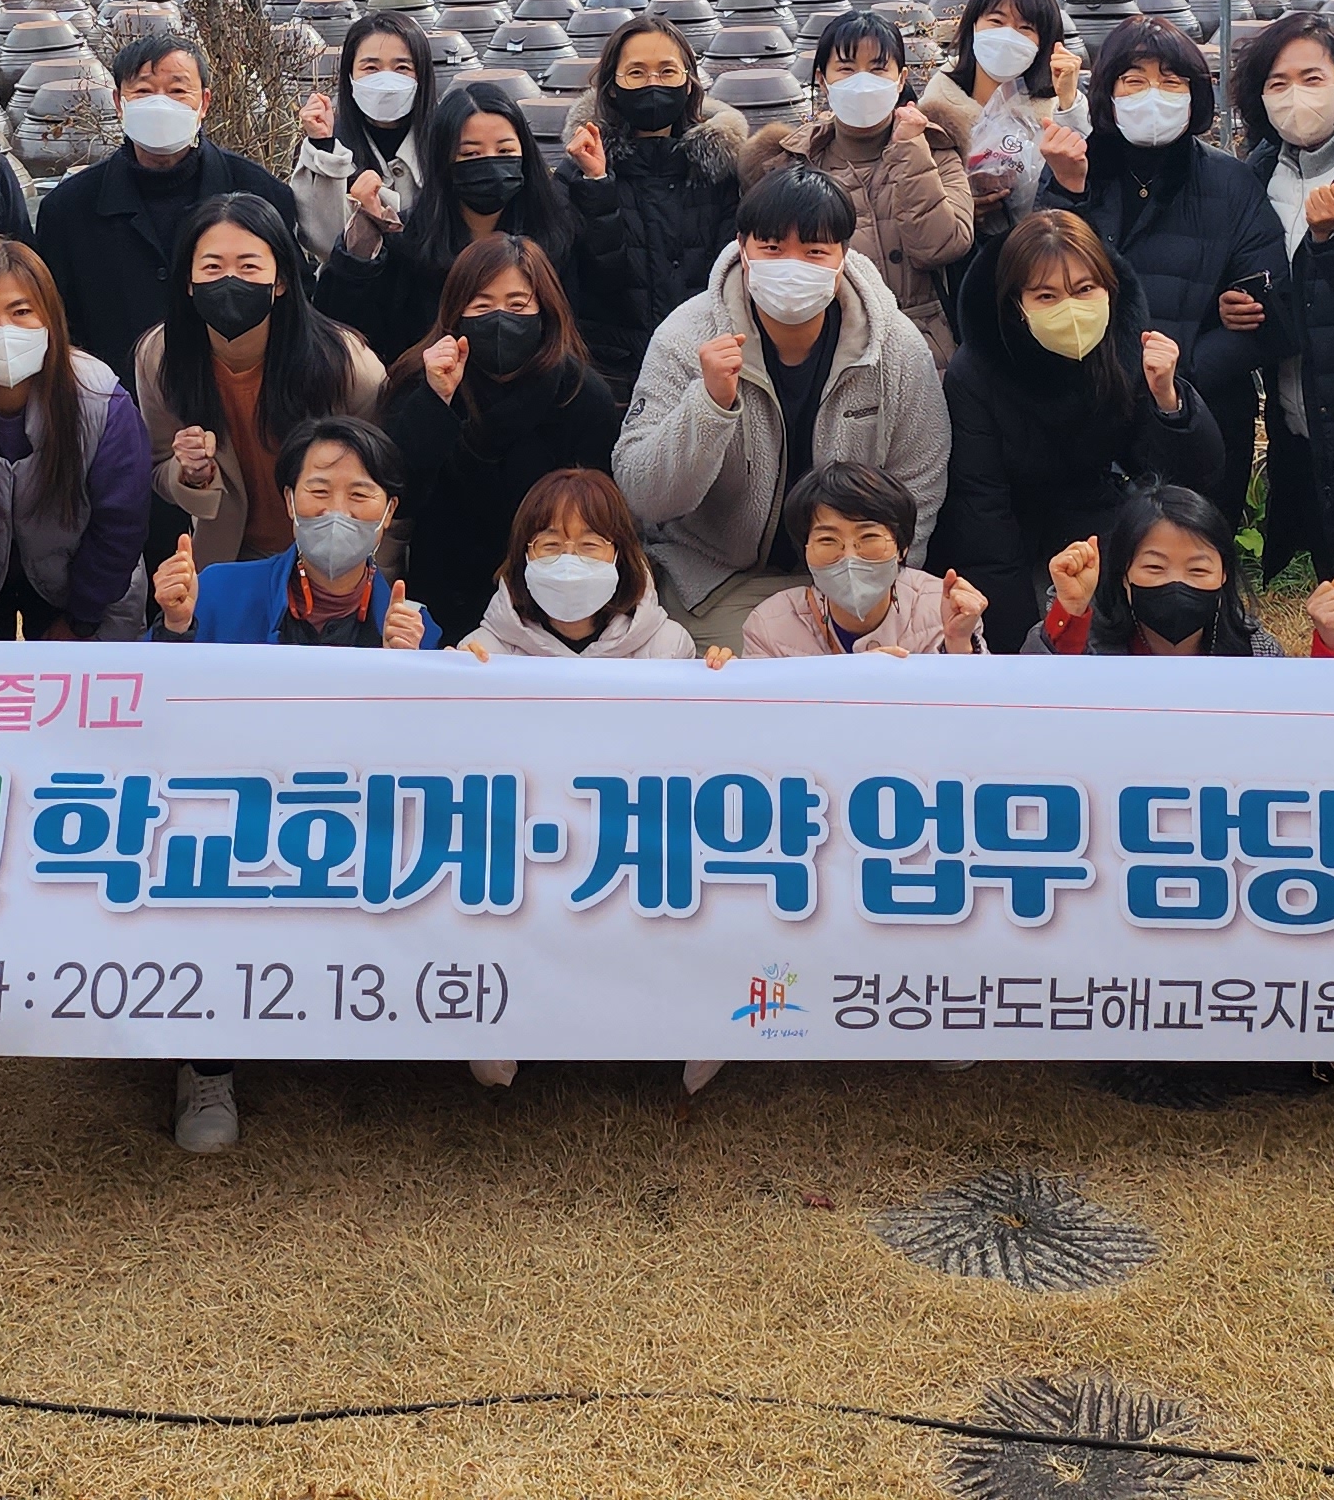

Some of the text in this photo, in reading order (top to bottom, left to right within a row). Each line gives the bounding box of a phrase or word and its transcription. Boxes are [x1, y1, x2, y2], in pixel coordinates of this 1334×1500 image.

[32, 771, 822, 913] 학교회계·계약
[848, 776, 1089, 919] 업무
[51, 961, 215, 1021] 2022.
[235, 961, 307, 1021] 12.
[326, 961, 398, 1022] 13.
[415, 961, 509, 1025] (화)
